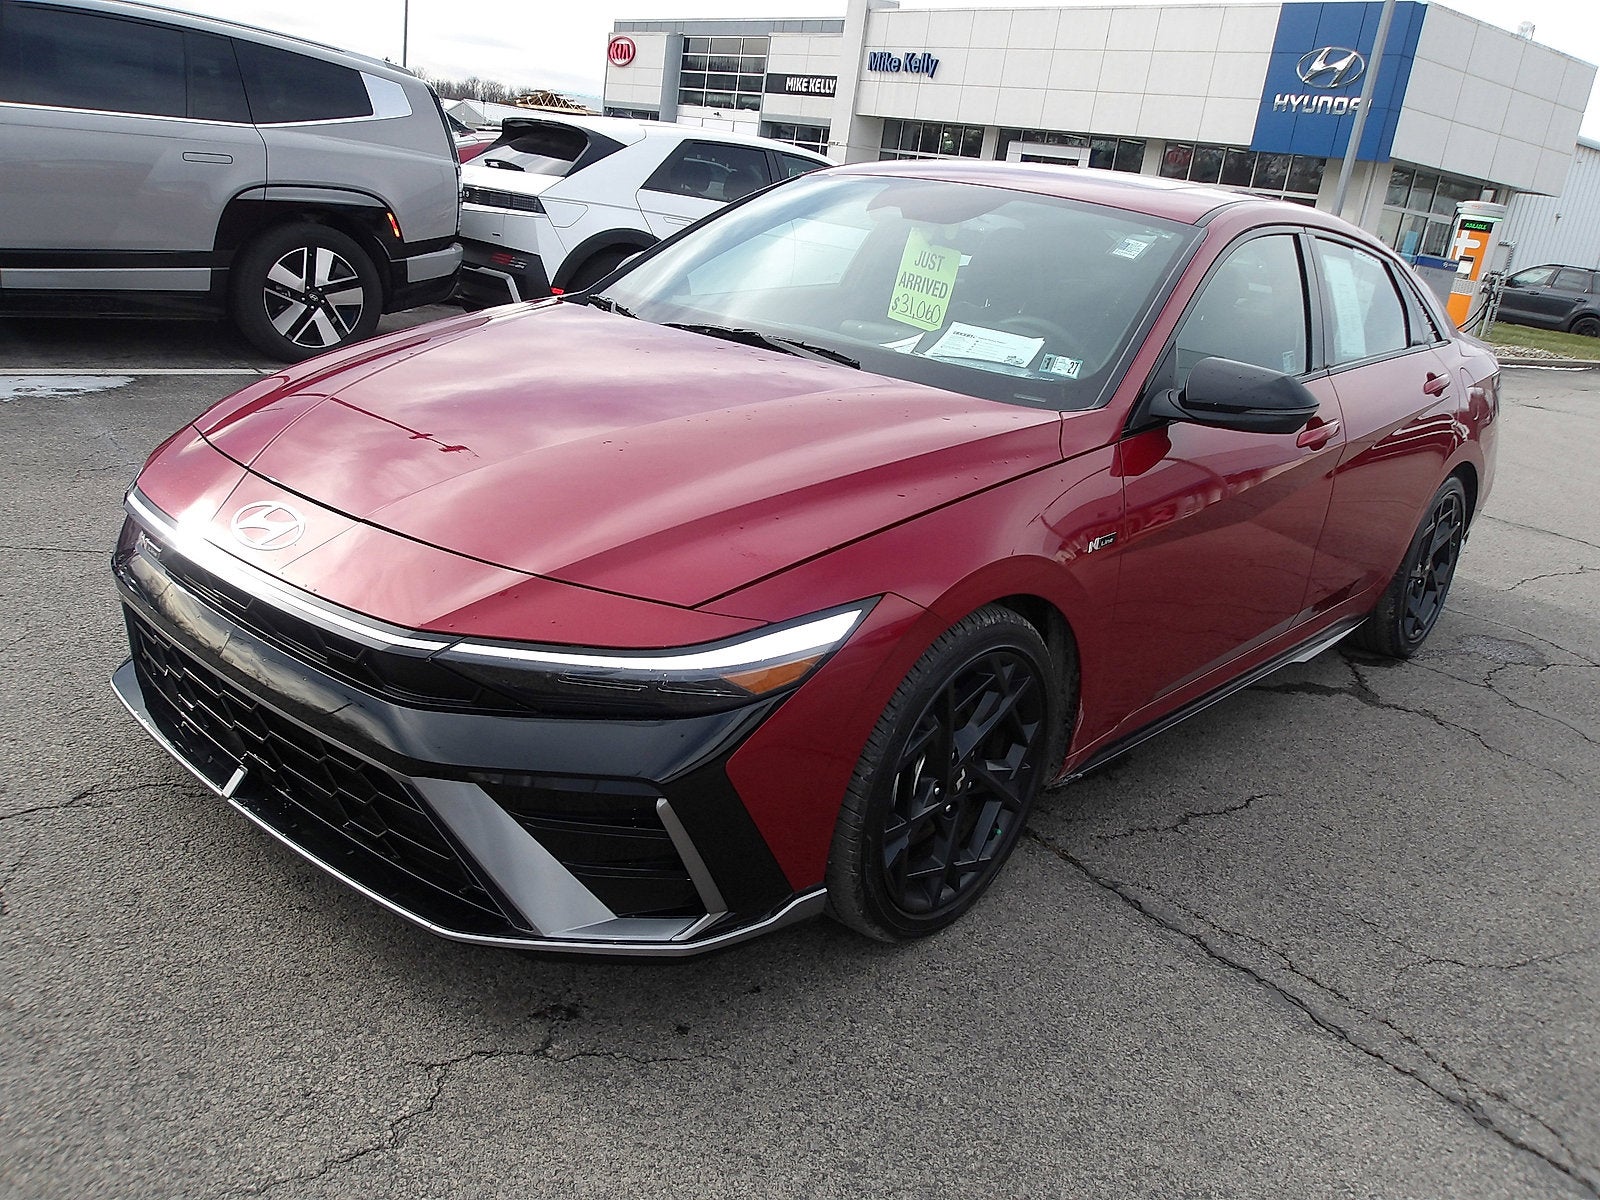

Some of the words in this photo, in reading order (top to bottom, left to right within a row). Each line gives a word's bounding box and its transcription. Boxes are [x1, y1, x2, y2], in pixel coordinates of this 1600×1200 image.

[609, 42, 630, 60] KIA
[868, 52, 901, 73] Mike
[902, 52, 939, 79] Kelly
[785, 76, 808, 93] MIKE
[808, 78, 837, 94] KELLY
[914, 250, 945, 273] JUST
[898, 271, 949, 300] ARRIVED
[891, 292, 942, 324] $31,060
[1067, 361, 1080, 375] 27
